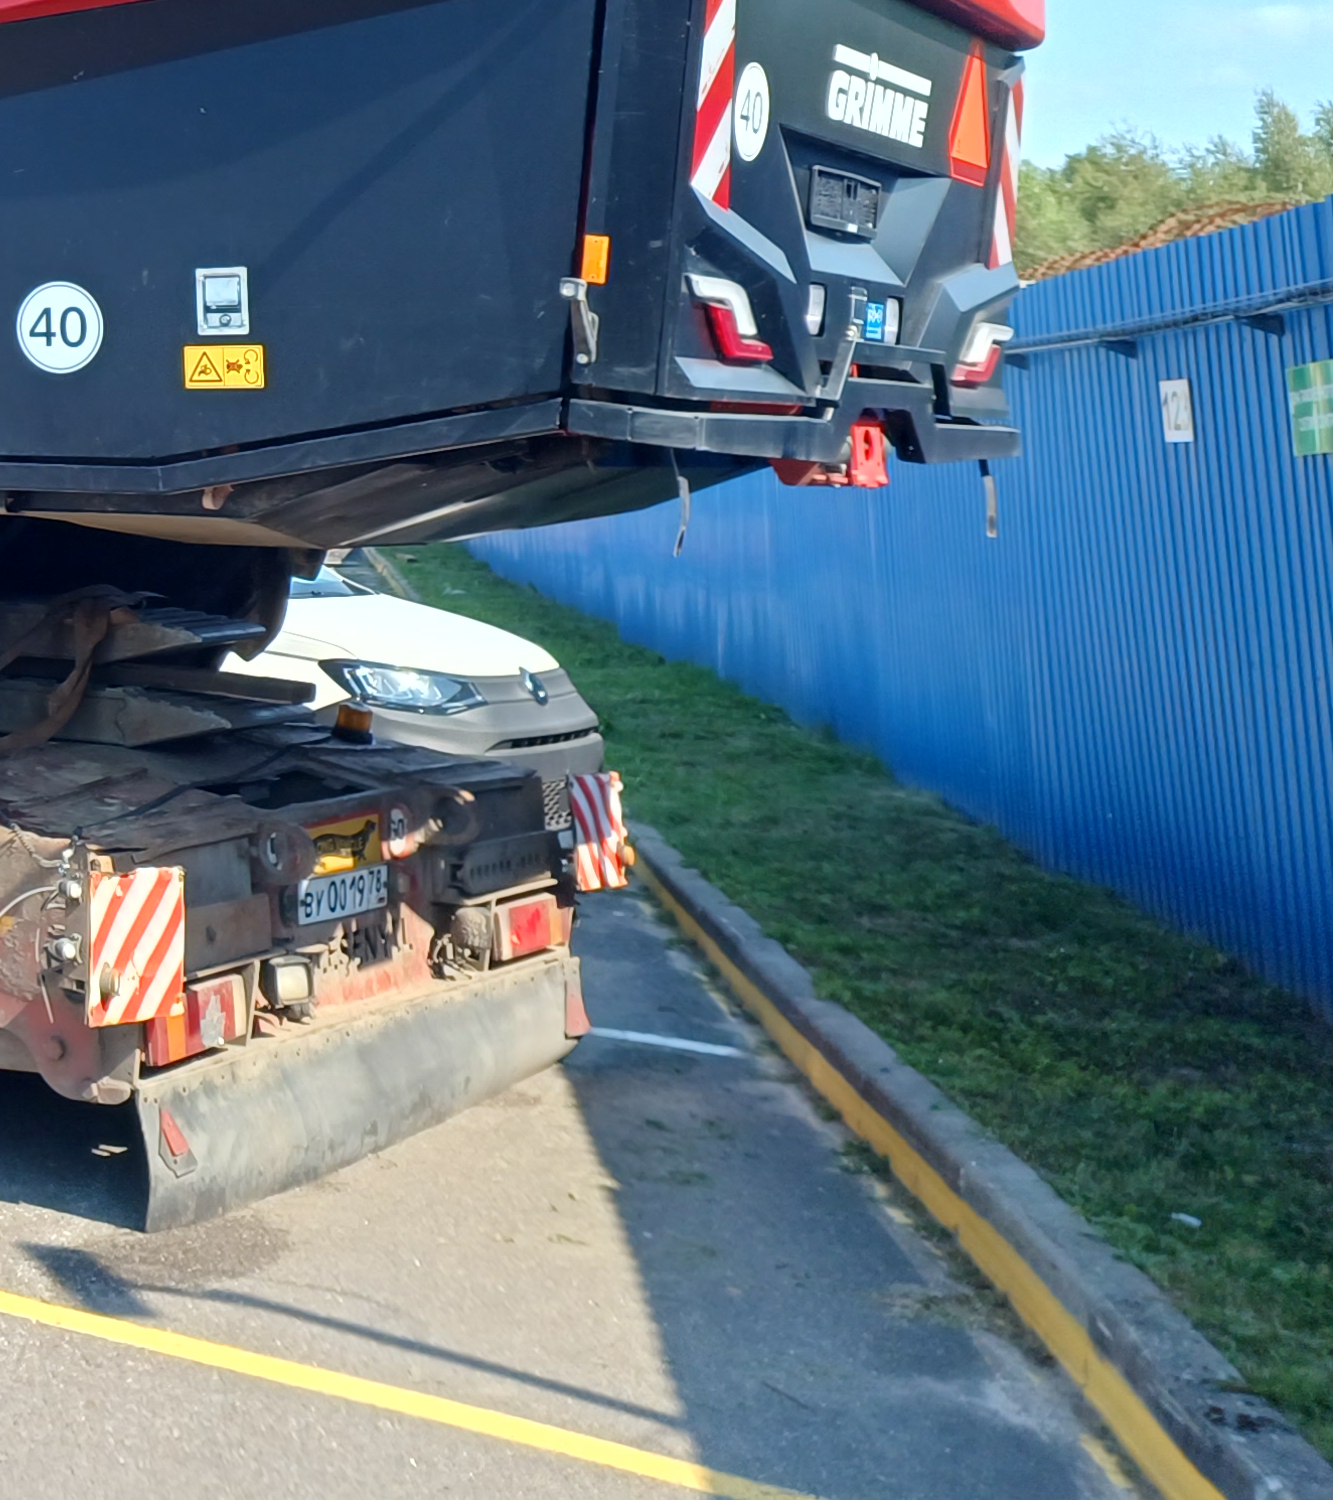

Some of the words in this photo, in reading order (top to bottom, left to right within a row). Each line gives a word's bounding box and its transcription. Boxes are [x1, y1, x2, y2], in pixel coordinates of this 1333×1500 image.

[739, 88, 763, 134] 40
[825, 52, 930, 149] GRIMME
[28, 305, 88, 348] 40
